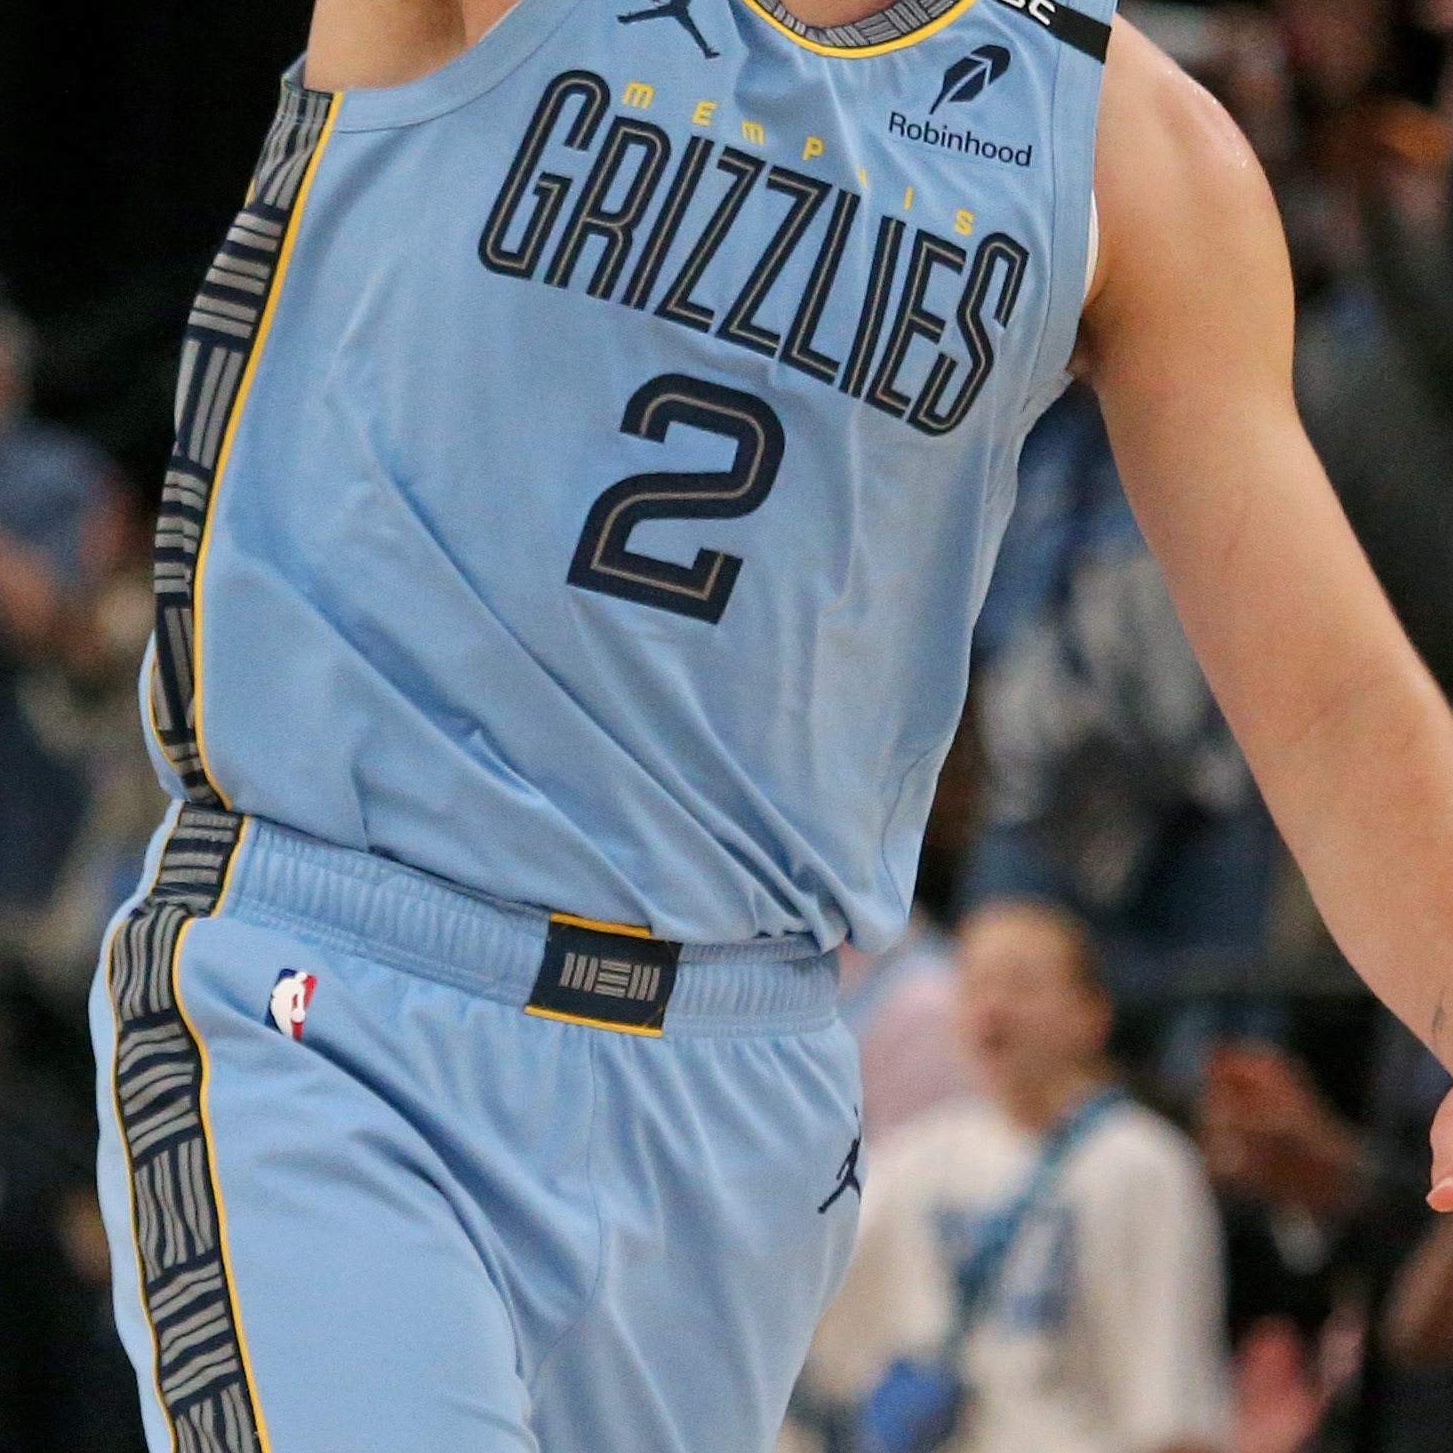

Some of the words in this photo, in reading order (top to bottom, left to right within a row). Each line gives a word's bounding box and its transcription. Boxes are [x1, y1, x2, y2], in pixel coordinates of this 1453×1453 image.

[478, 69, 1030, 436] GRIZZLIES
[888, 111, 1033, 167] Robinhood
[566, 373, 786, 625] 2
